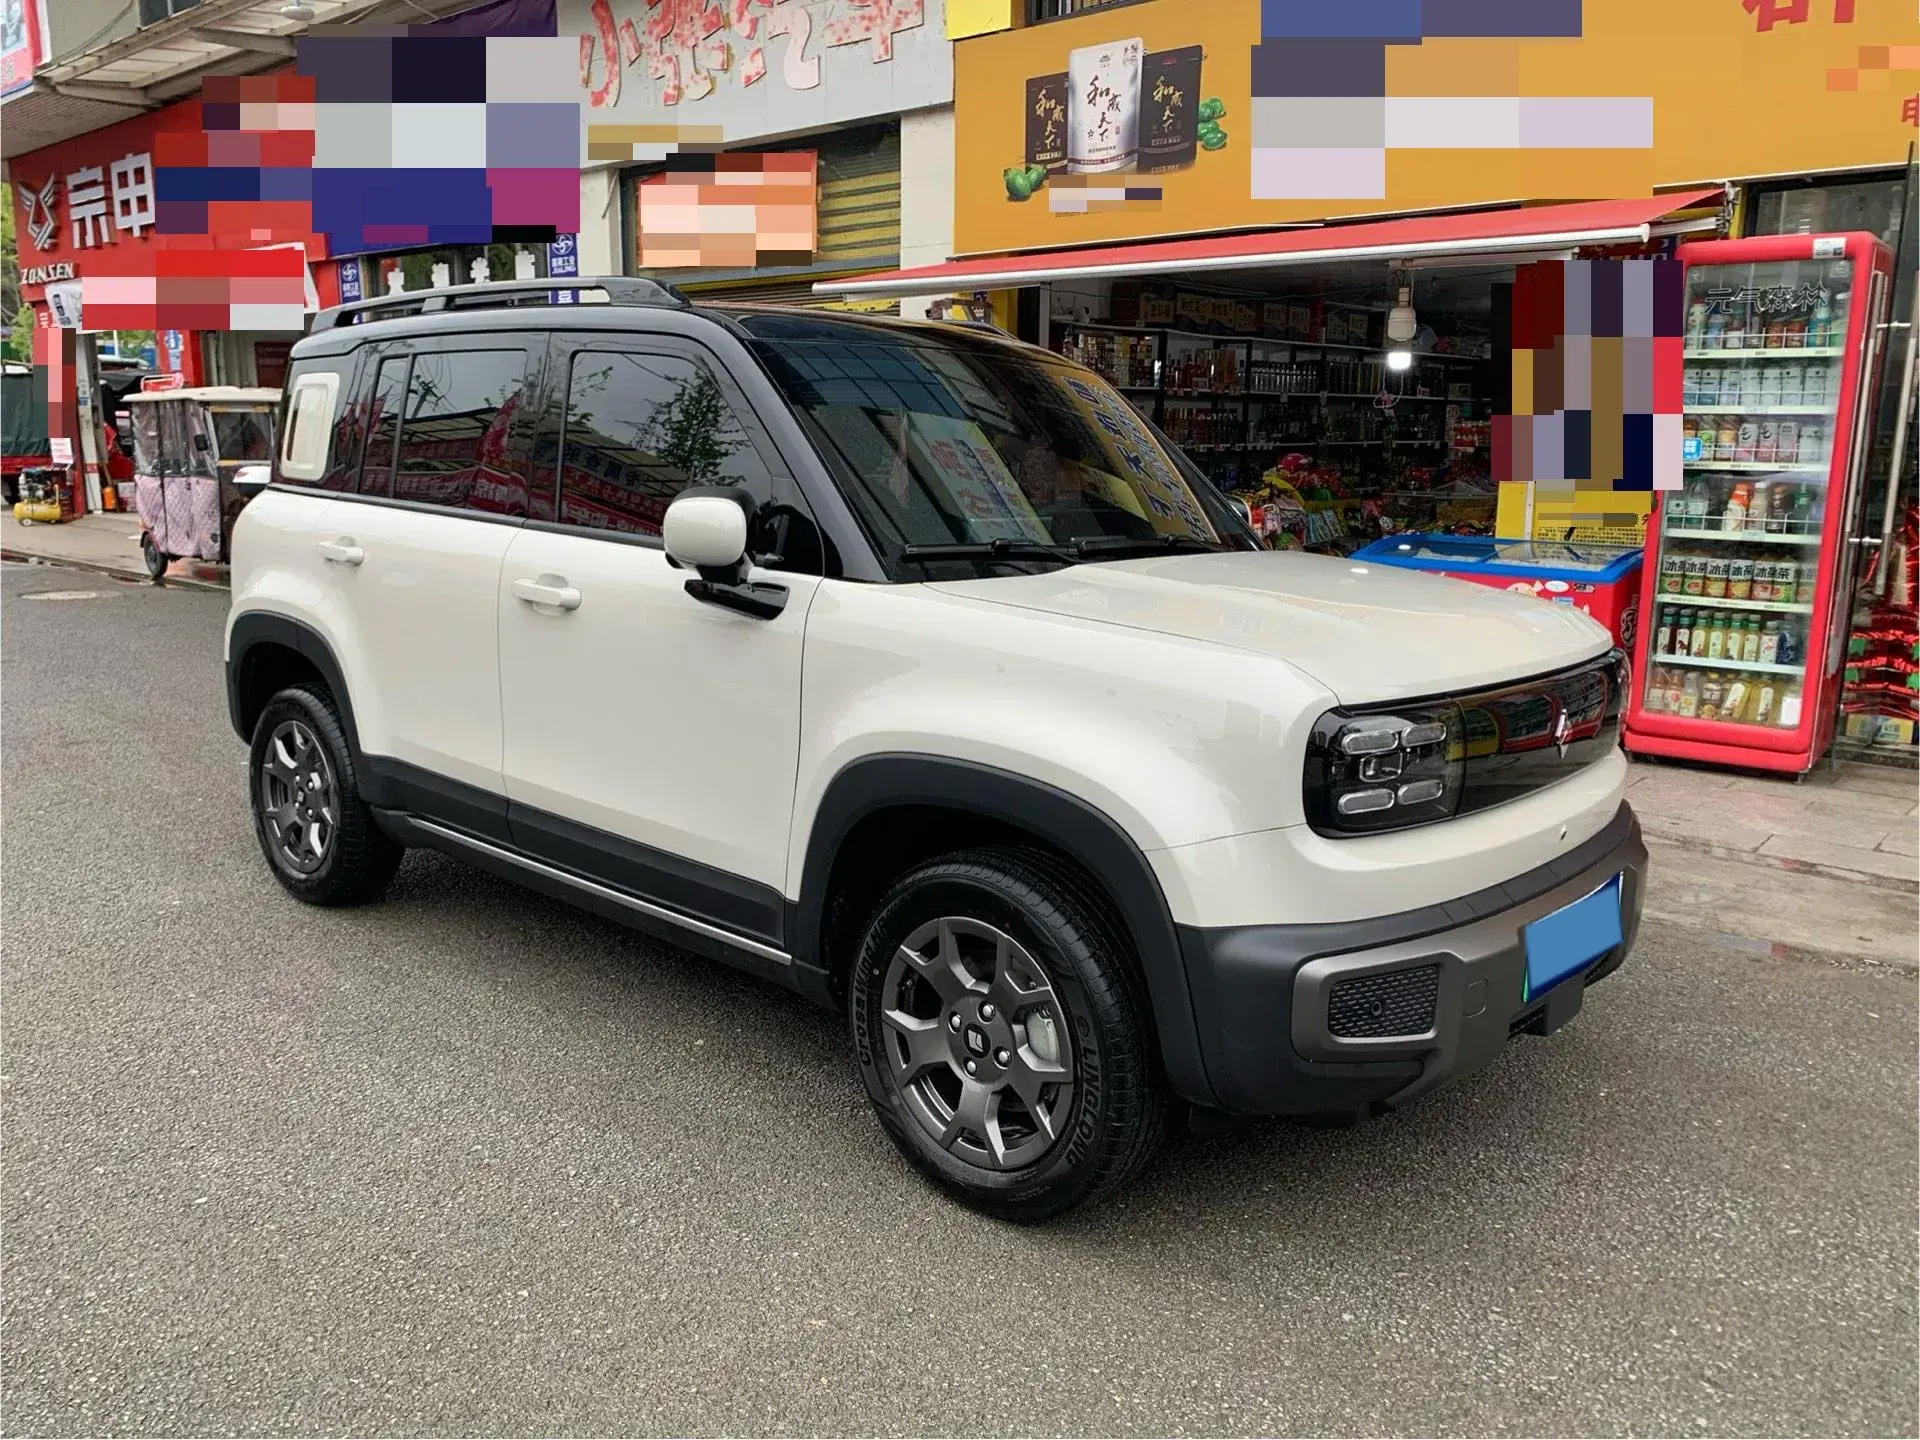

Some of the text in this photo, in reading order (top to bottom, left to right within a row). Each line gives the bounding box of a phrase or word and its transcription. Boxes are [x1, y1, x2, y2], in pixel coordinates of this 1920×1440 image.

[66, 153, 155, 249] 宗申
[1704, 281, 1828, 314] 元气森林
[1064, 1046, 1100, 1167] LINGLONG
